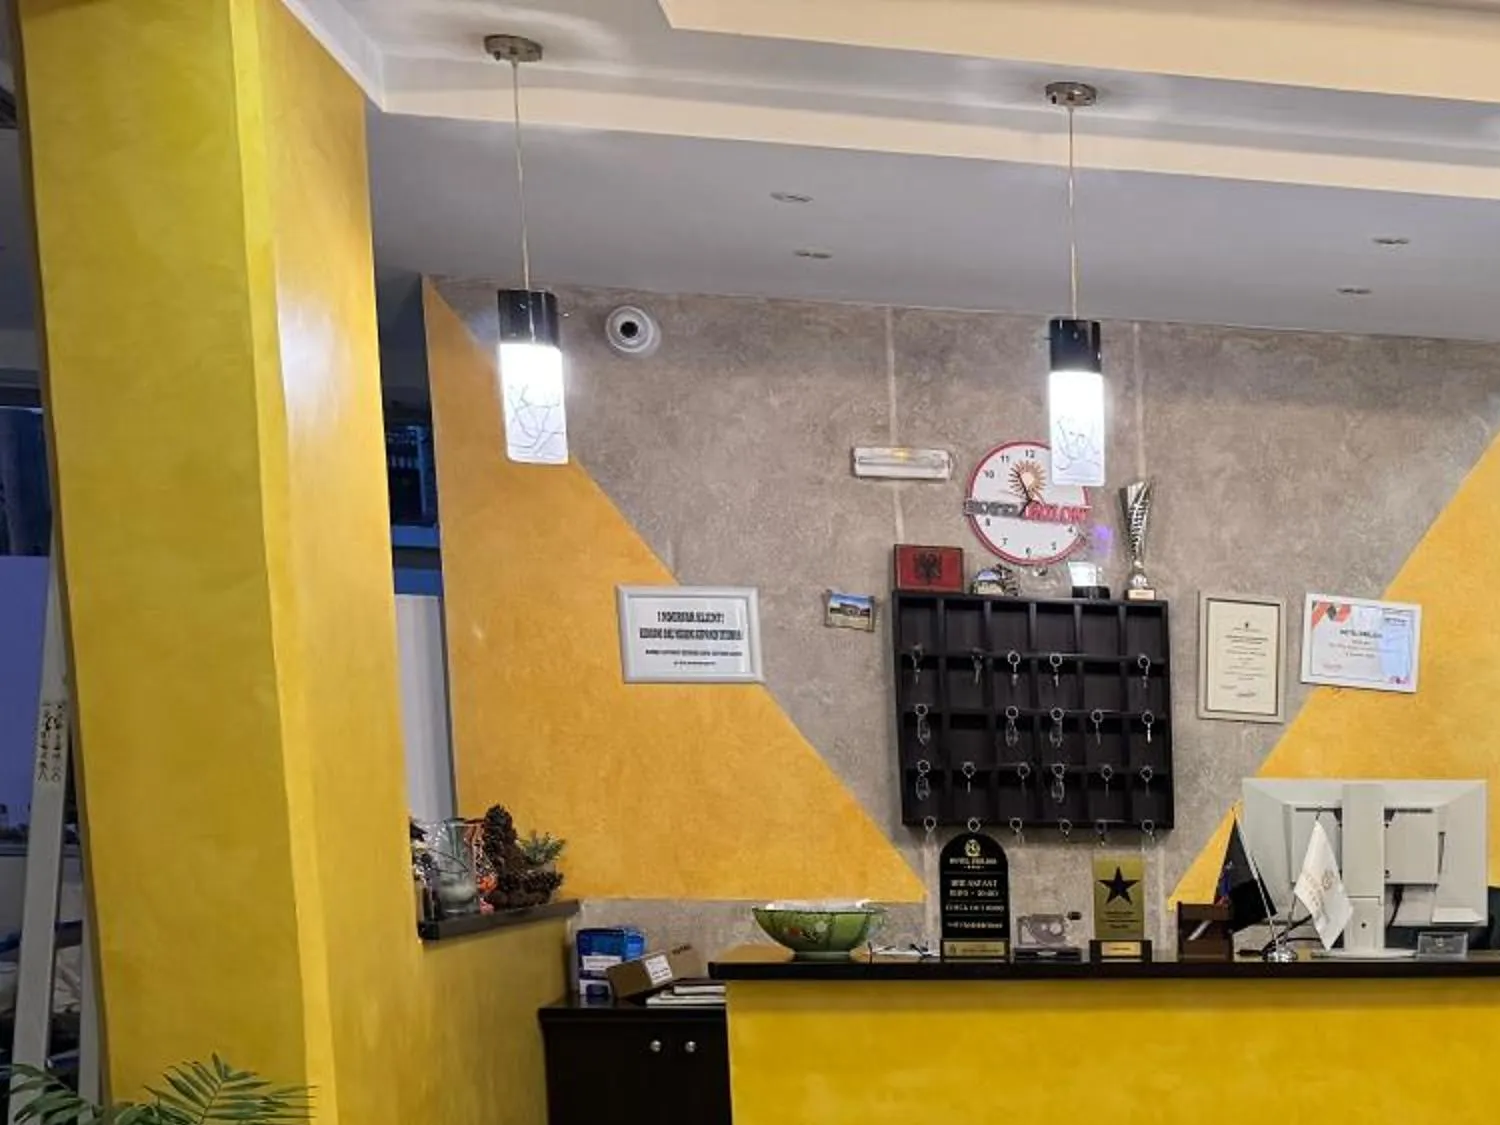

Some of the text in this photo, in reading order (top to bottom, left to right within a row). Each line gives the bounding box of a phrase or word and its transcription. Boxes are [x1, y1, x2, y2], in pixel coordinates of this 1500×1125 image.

[1025, 449, 1035, 458] 12
[1000, 455, 1010, 463] 11
[984, 470, 995, 479] 10
